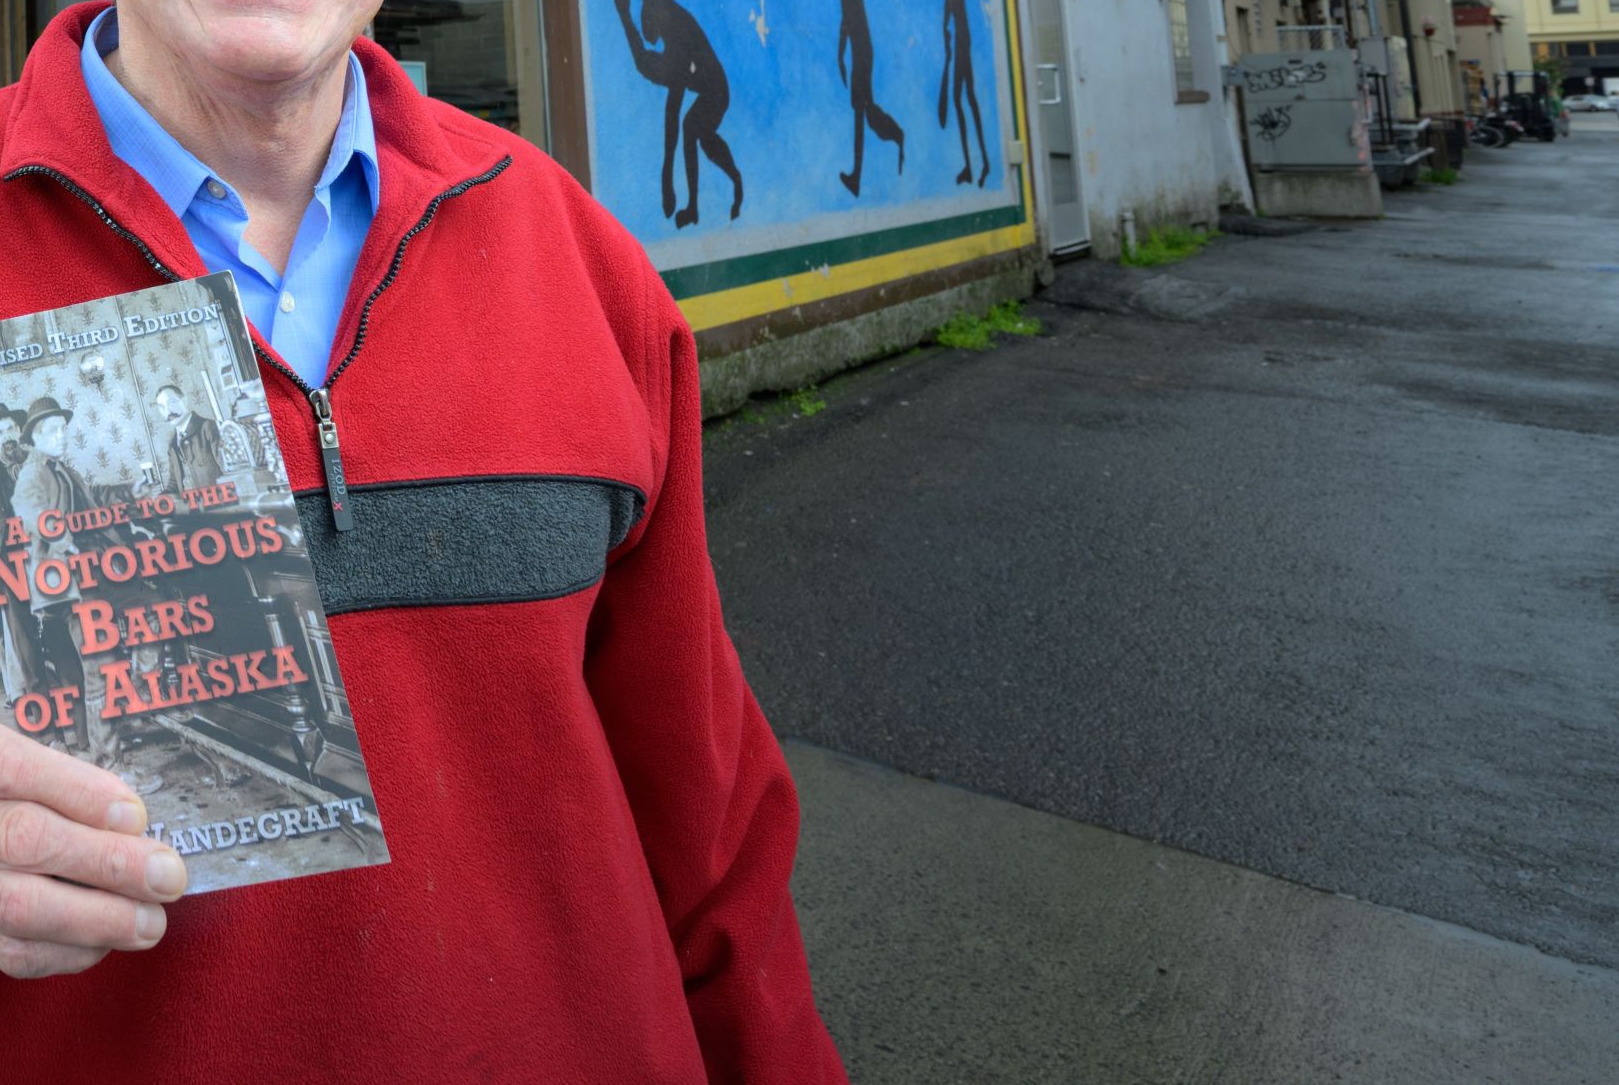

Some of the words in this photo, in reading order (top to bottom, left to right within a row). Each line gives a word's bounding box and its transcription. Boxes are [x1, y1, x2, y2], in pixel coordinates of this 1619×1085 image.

[48, 324, 120, 355] THIRD
[123, 302, 220, 337] EDITION
[331, 458, 346, 495] IZOD
[5, 516, 31, 547] A
[37, 503, 129, 540] GUIDE
[136, 494, 175, 518] TO
[183, 482, 239, 511] THE
[73, 595, 215, 656] BARS
[14, 686, 80, 733] OF
[100, 645, 309, 720] ALASKA
